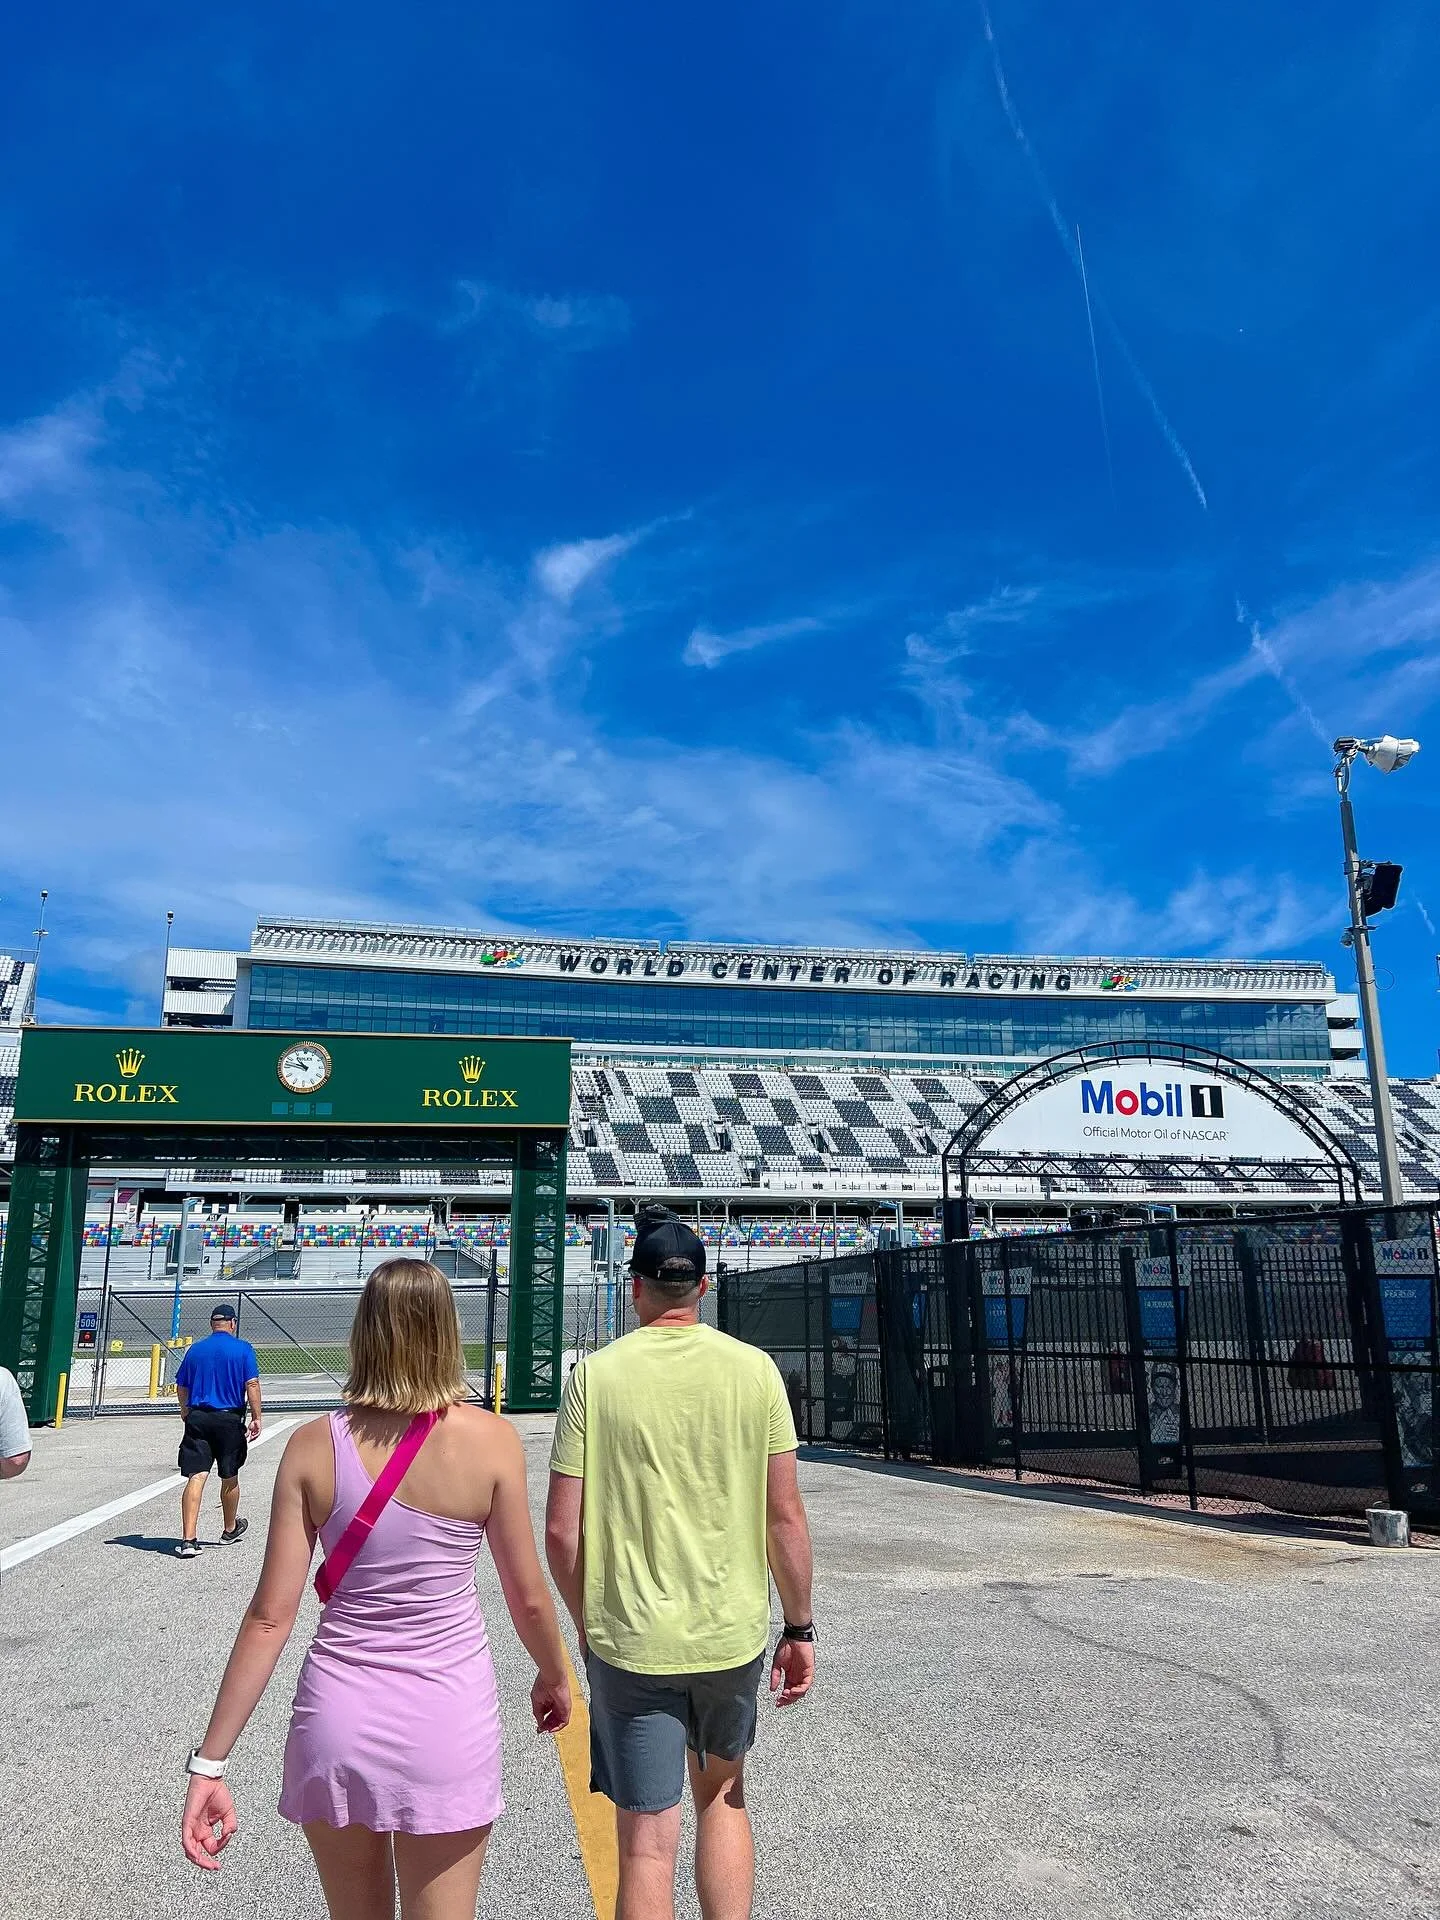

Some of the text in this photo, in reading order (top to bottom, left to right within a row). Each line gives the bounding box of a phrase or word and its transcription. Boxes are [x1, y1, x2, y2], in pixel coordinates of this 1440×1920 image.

[559, 954, 1071, 992] WORLD CENTER OF RACING
[73, 1083, 179, 1103] ROLEX
[421, 1088, 519, 1108] ROLEX
[1081, 1079, 1183, 1117] Mobil
[1083, 1126, 1227, 1141] Official Motor Oil of NASCAR
[80, 1319, 96, 1328] 509
